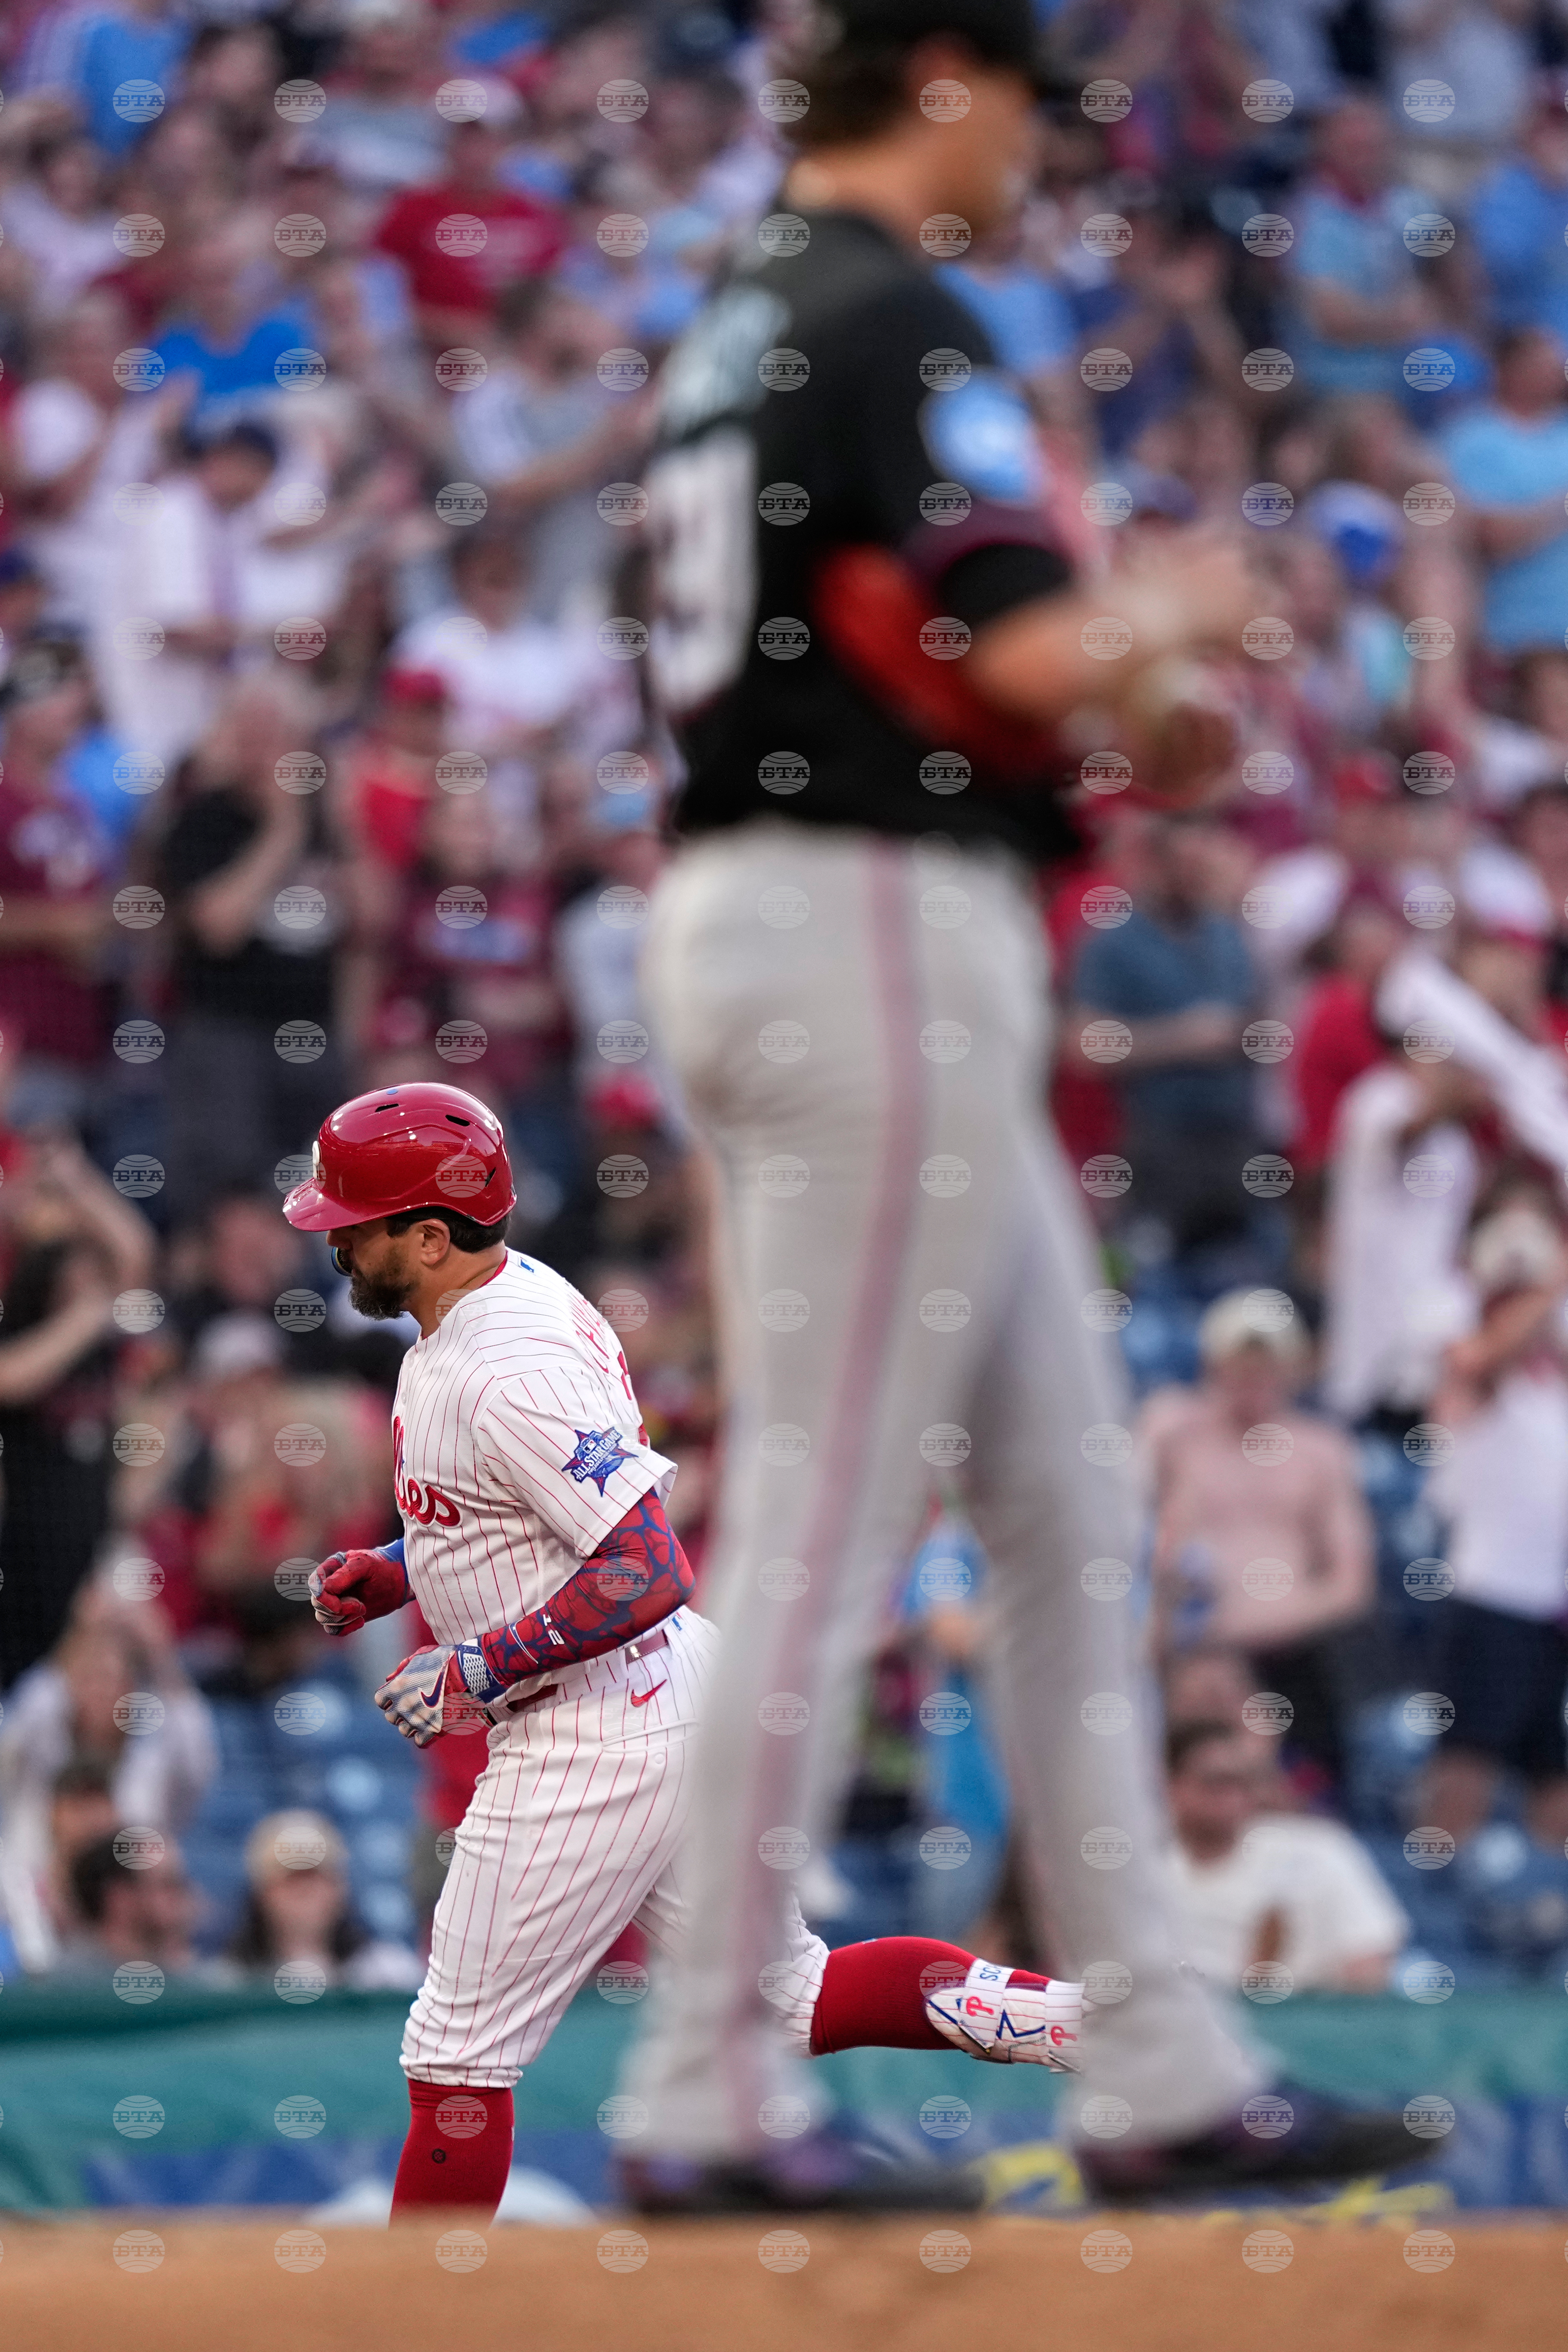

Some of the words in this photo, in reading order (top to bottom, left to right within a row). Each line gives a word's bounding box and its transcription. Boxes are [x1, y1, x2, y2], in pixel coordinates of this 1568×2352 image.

[573, 1463, 591, 1480] ALL
[584, 1445, 606, 1467] STAR
[599, 1430, 620, 1450] GAME
[543, 1614, 565, 1646] 12
